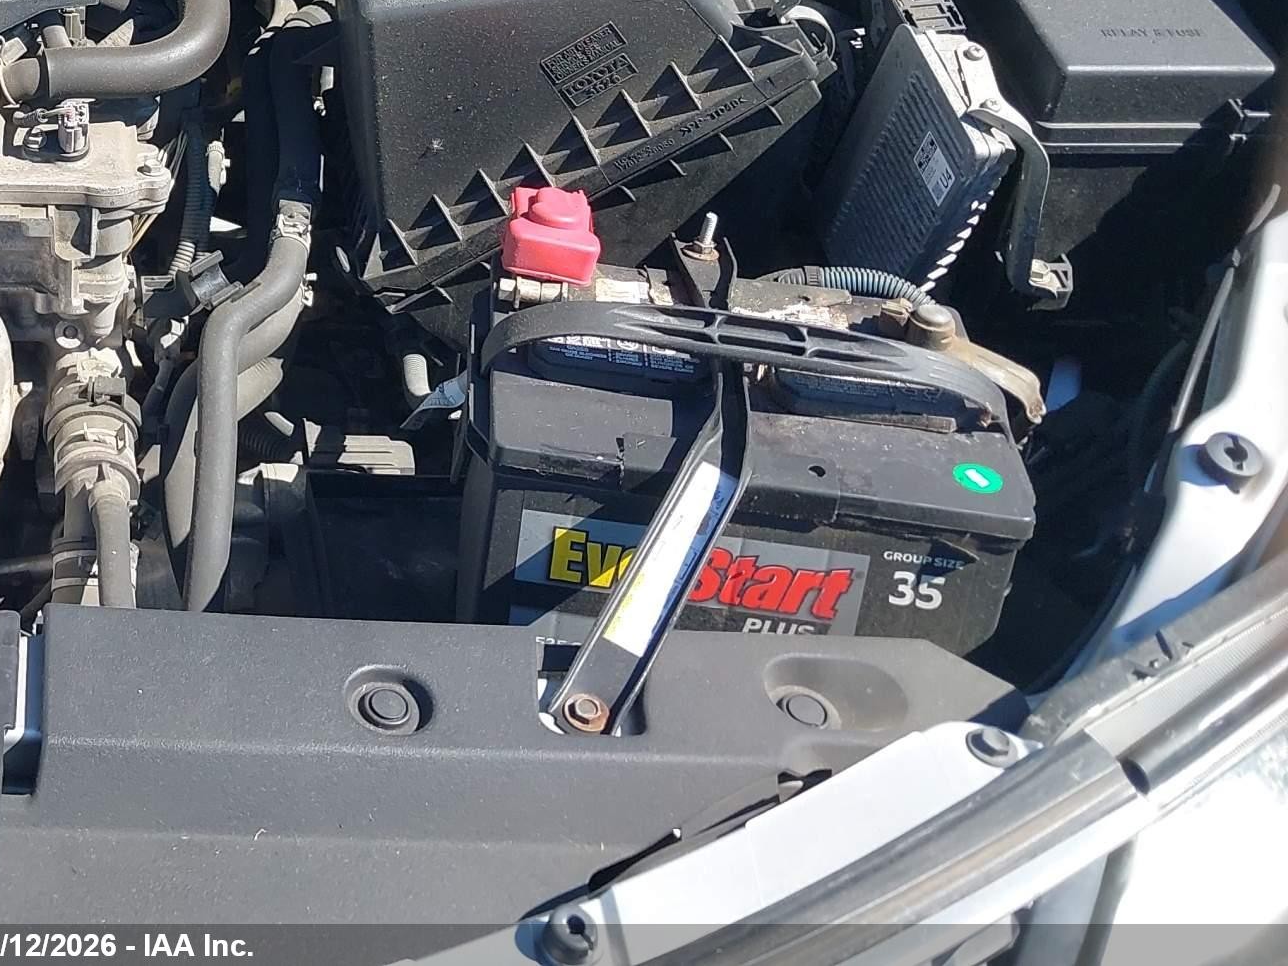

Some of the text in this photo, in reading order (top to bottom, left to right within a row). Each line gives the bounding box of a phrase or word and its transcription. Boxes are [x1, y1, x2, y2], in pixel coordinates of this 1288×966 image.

[566, 54, 630, 95] TOYOTA
[883, 550, 964, 570] GROUP SIZE
[888, 570, 946, 610] 35
